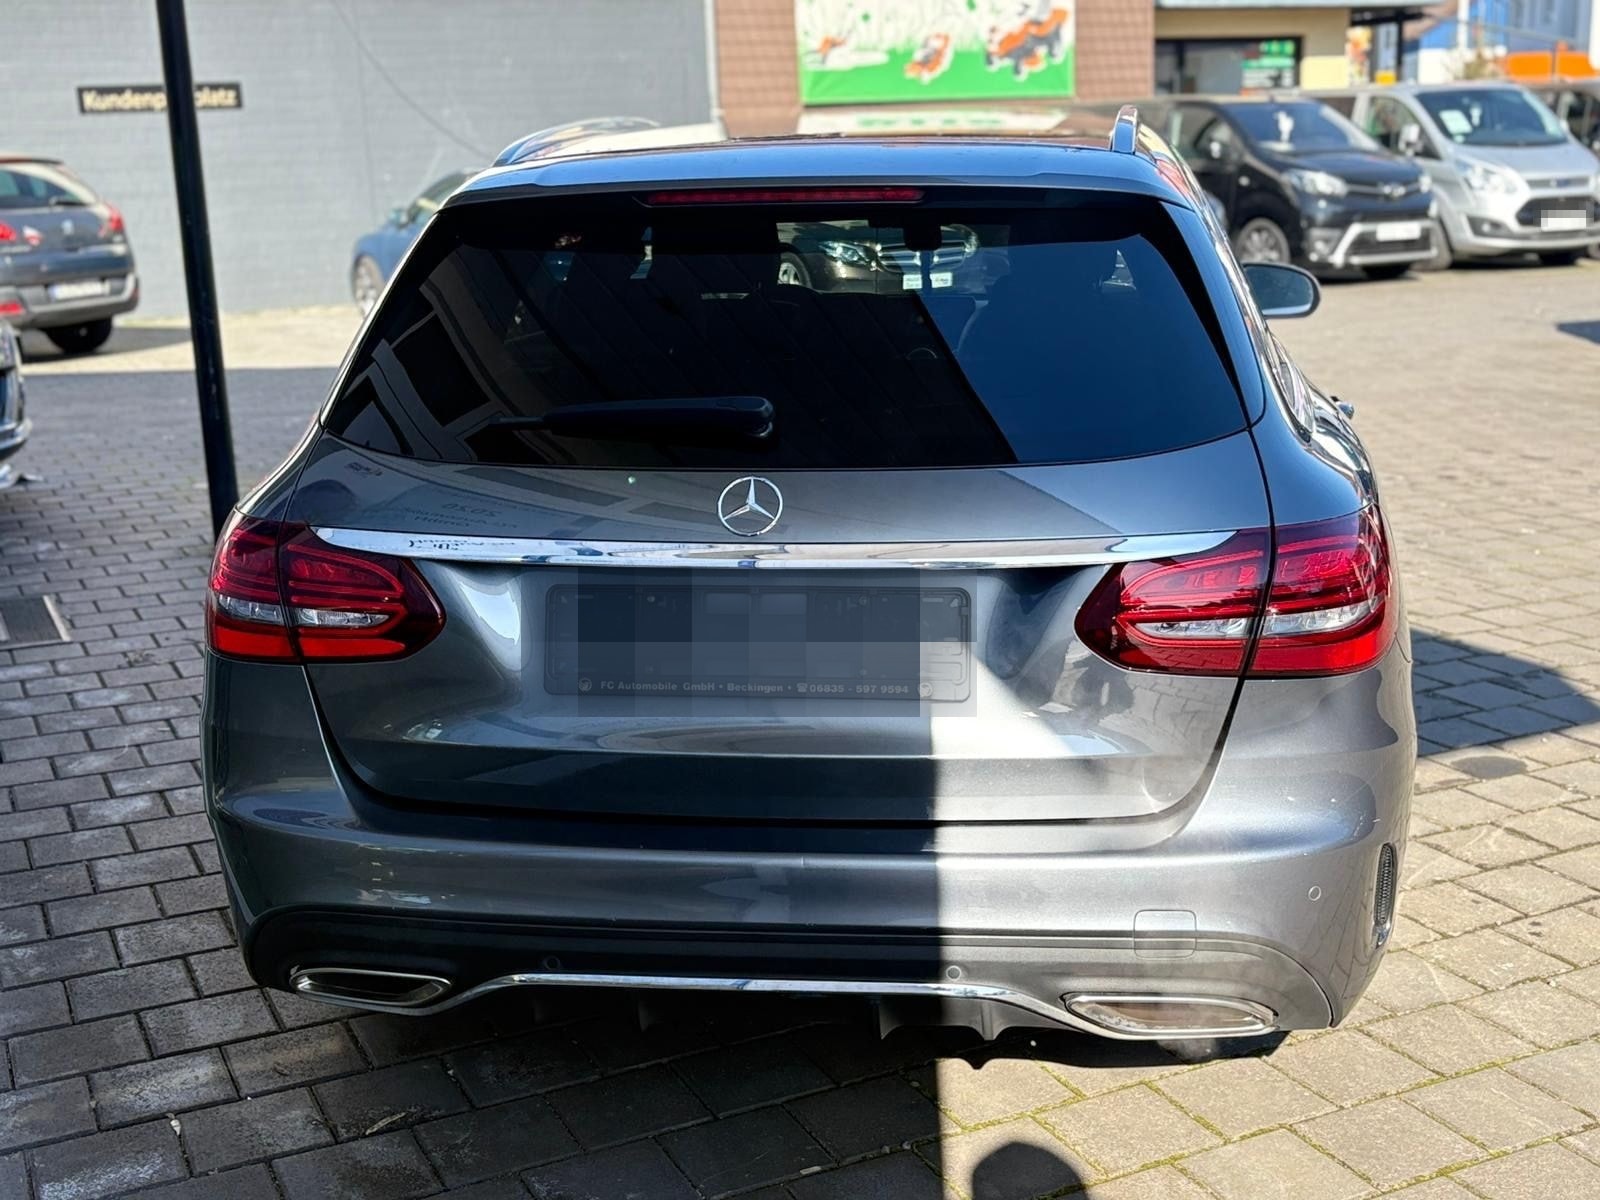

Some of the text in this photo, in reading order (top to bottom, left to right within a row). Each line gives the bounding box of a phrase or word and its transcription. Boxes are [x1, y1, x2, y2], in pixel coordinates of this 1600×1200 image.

[82, 86, 236, 112] Kundenpplatz
[600, 681, 615, 690] FC
[618, 681, 678, 691] Automobile
[683, 682, 715, 692] GmbH
[727, 683, 784, 694] Beckingen
[809, 684, 845, 693] 06835
[856, 684, 876, 694] 597
[880, 685, 909, 694] 9594
